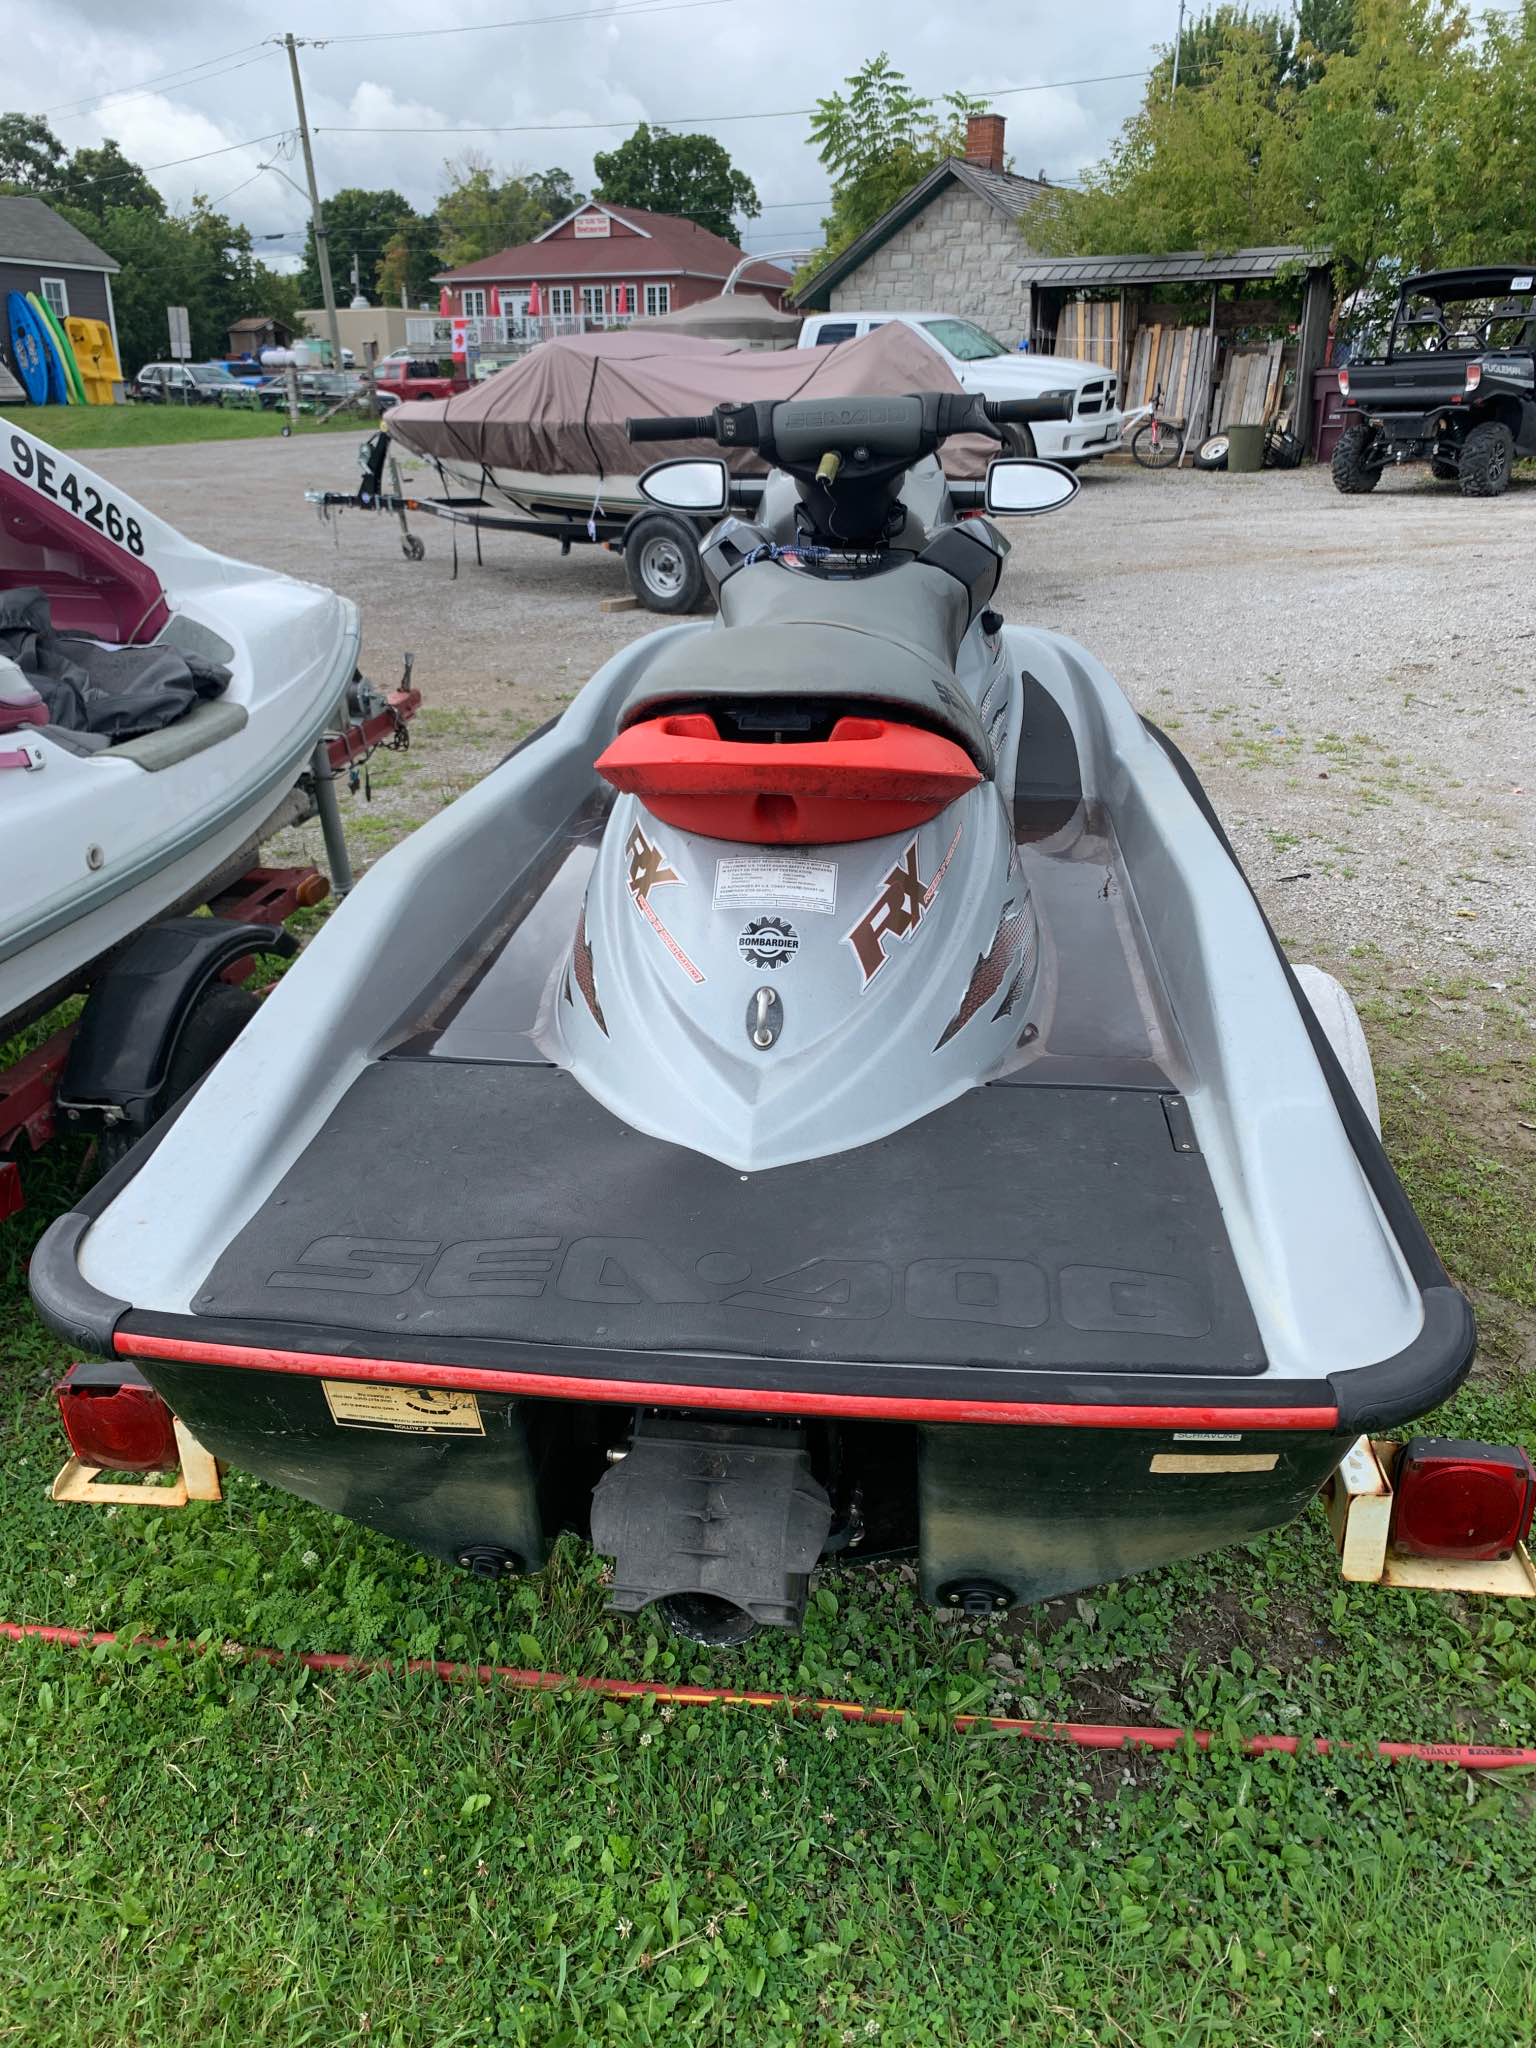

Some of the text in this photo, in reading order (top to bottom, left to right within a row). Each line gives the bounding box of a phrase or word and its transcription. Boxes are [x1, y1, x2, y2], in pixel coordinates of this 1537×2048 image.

[1482, 363, 1521, 376] FUGLEMAN
[10, 434, 144, 557] 9E4268
[739, 937, 799, 949] BOMBARDIER
[1419, 1747, 1462, 1757] STANLEY
